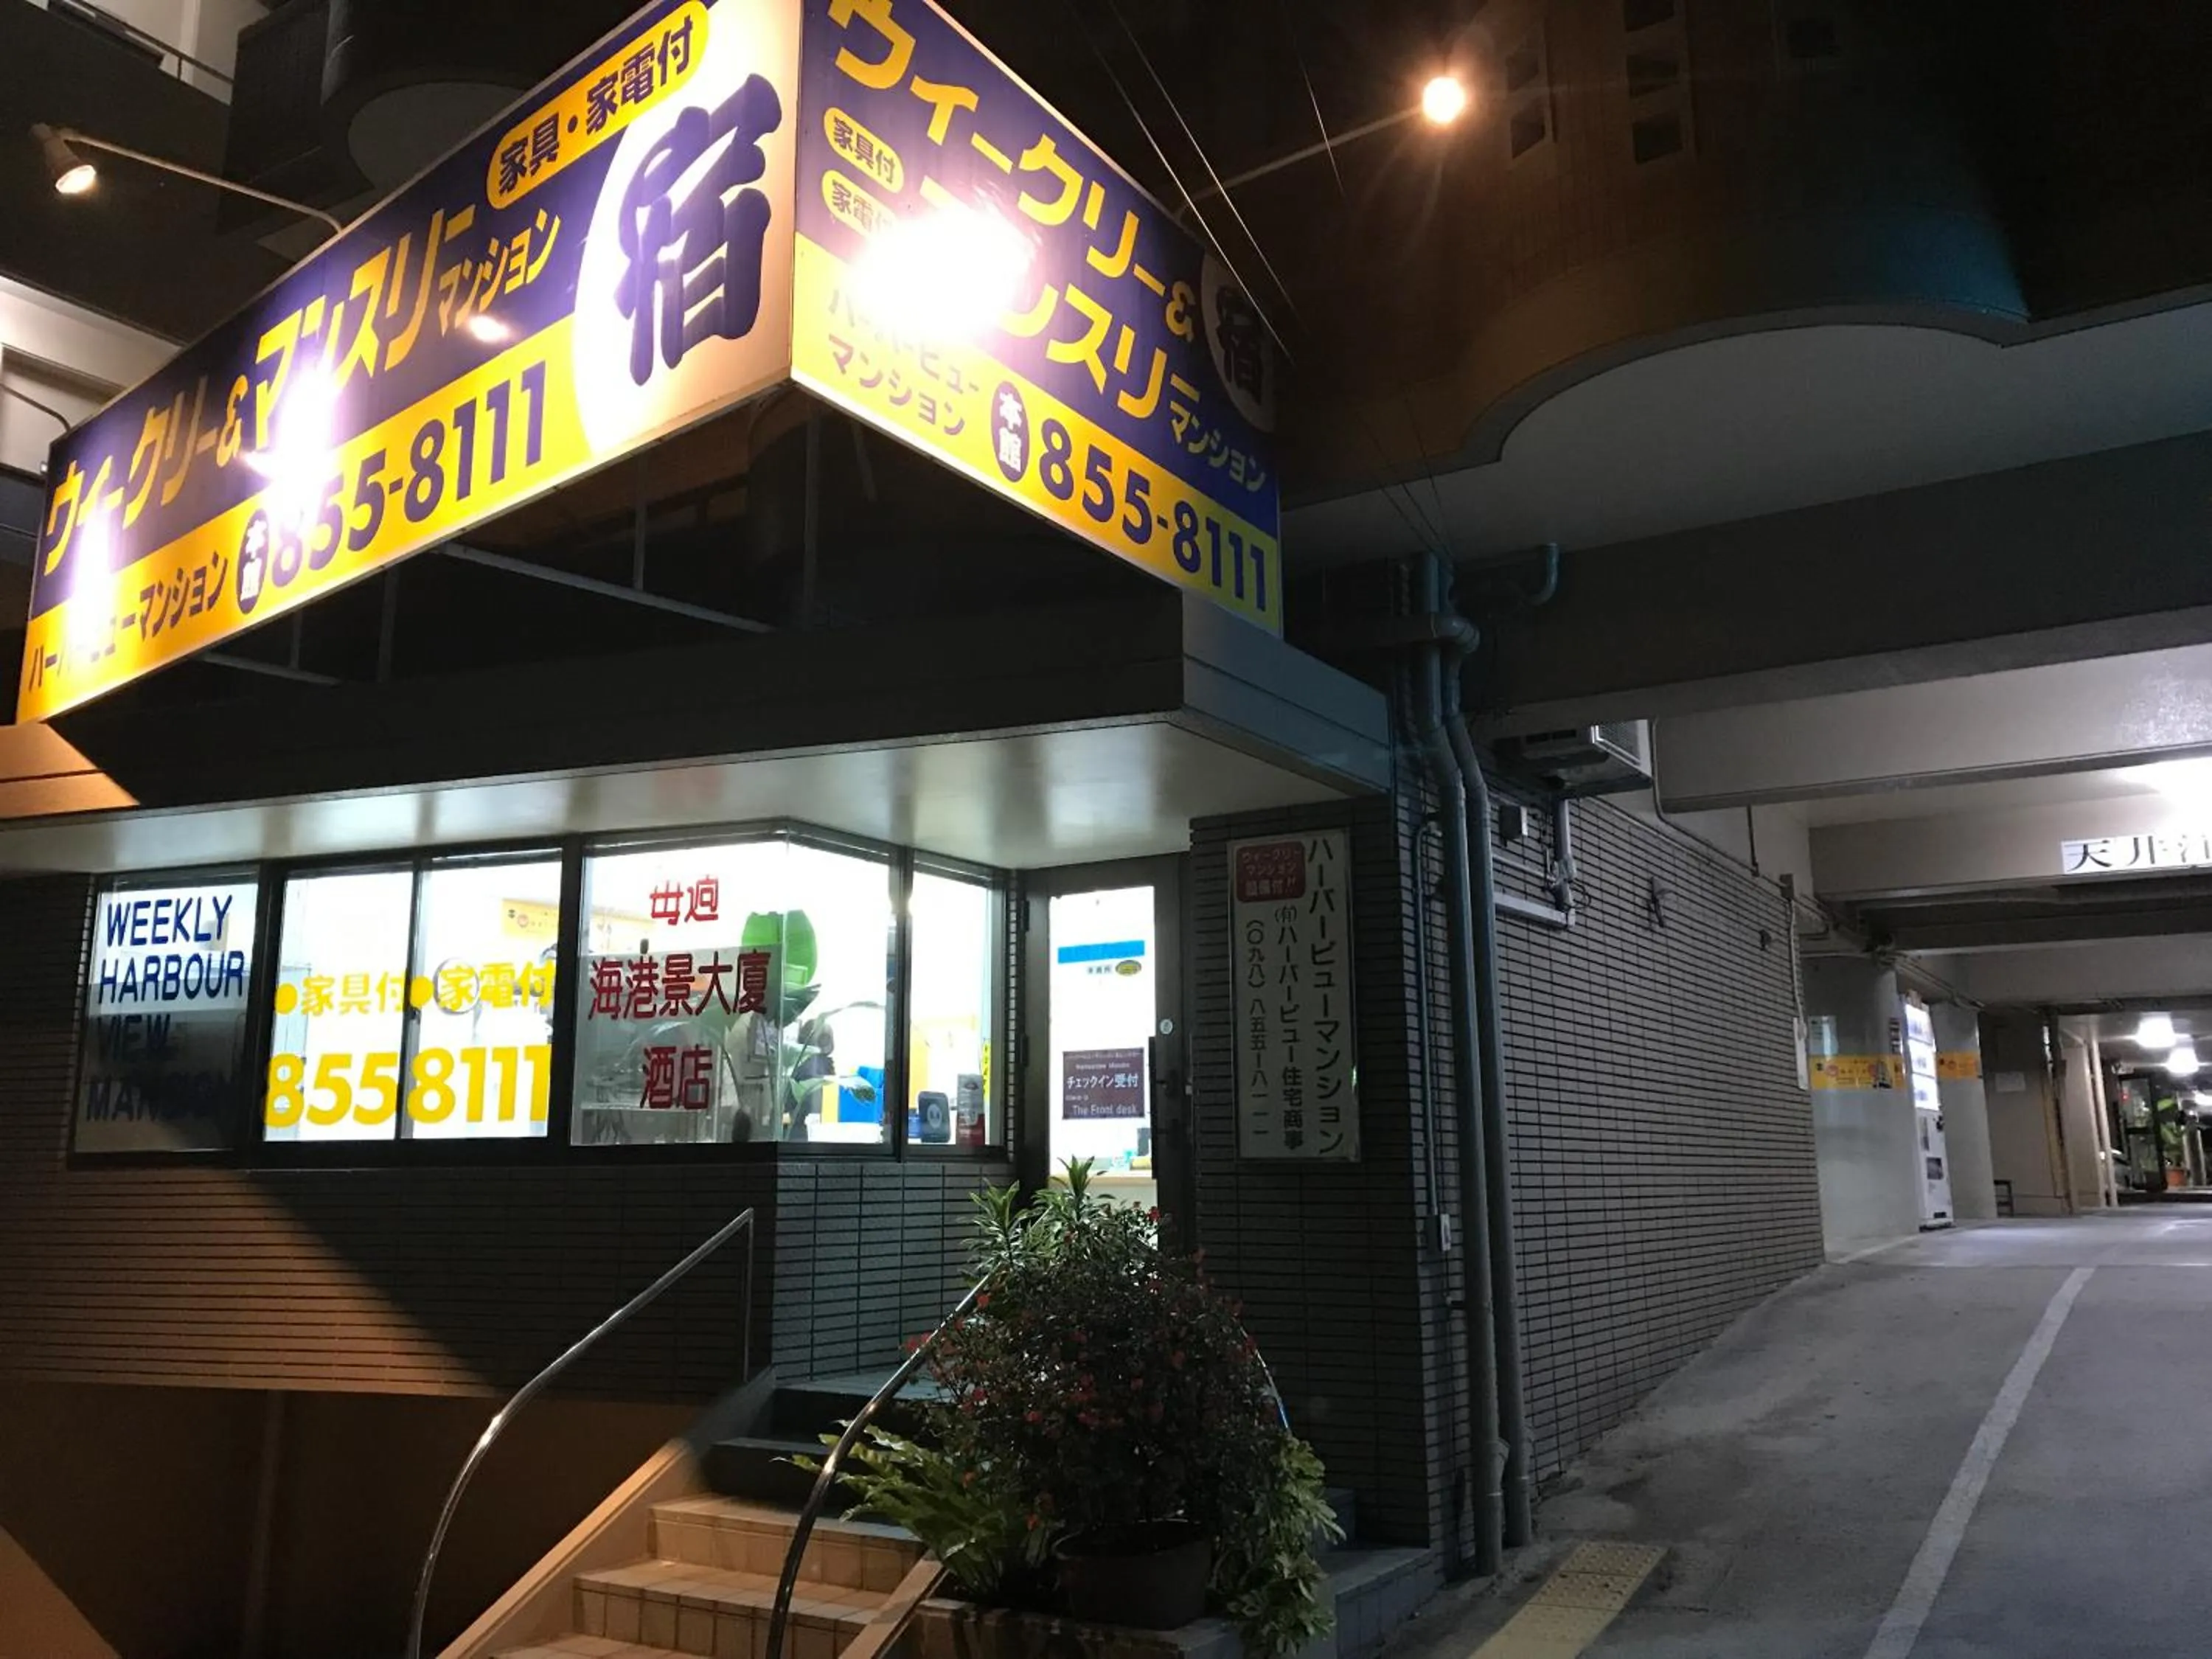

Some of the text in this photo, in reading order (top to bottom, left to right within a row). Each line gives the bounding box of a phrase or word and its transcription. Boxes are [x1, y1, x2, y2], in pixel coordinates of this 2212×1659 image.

[832, 114, 896, 184] 家具付
[613, 72, 782, 386] 宿
[828, 333, 966, 436] マンション
[271, 360, 546, 588] 855-8111
[1038, 417, 1267, 612] 855-8111
[106, 894, 234, 948] WEEKLY
[97, 950, 246, 1004] HARBOUR
[300, 960, 556, 1017] 家具付 家電付
[1307, 838, 1344, 1155] ハーバービューマンション
[639, 1045, 714, 1110] 酒店
[1066, 1072, 1139, 1090] チェックイン受付
[1071, 1105, 1088, 1116] The
